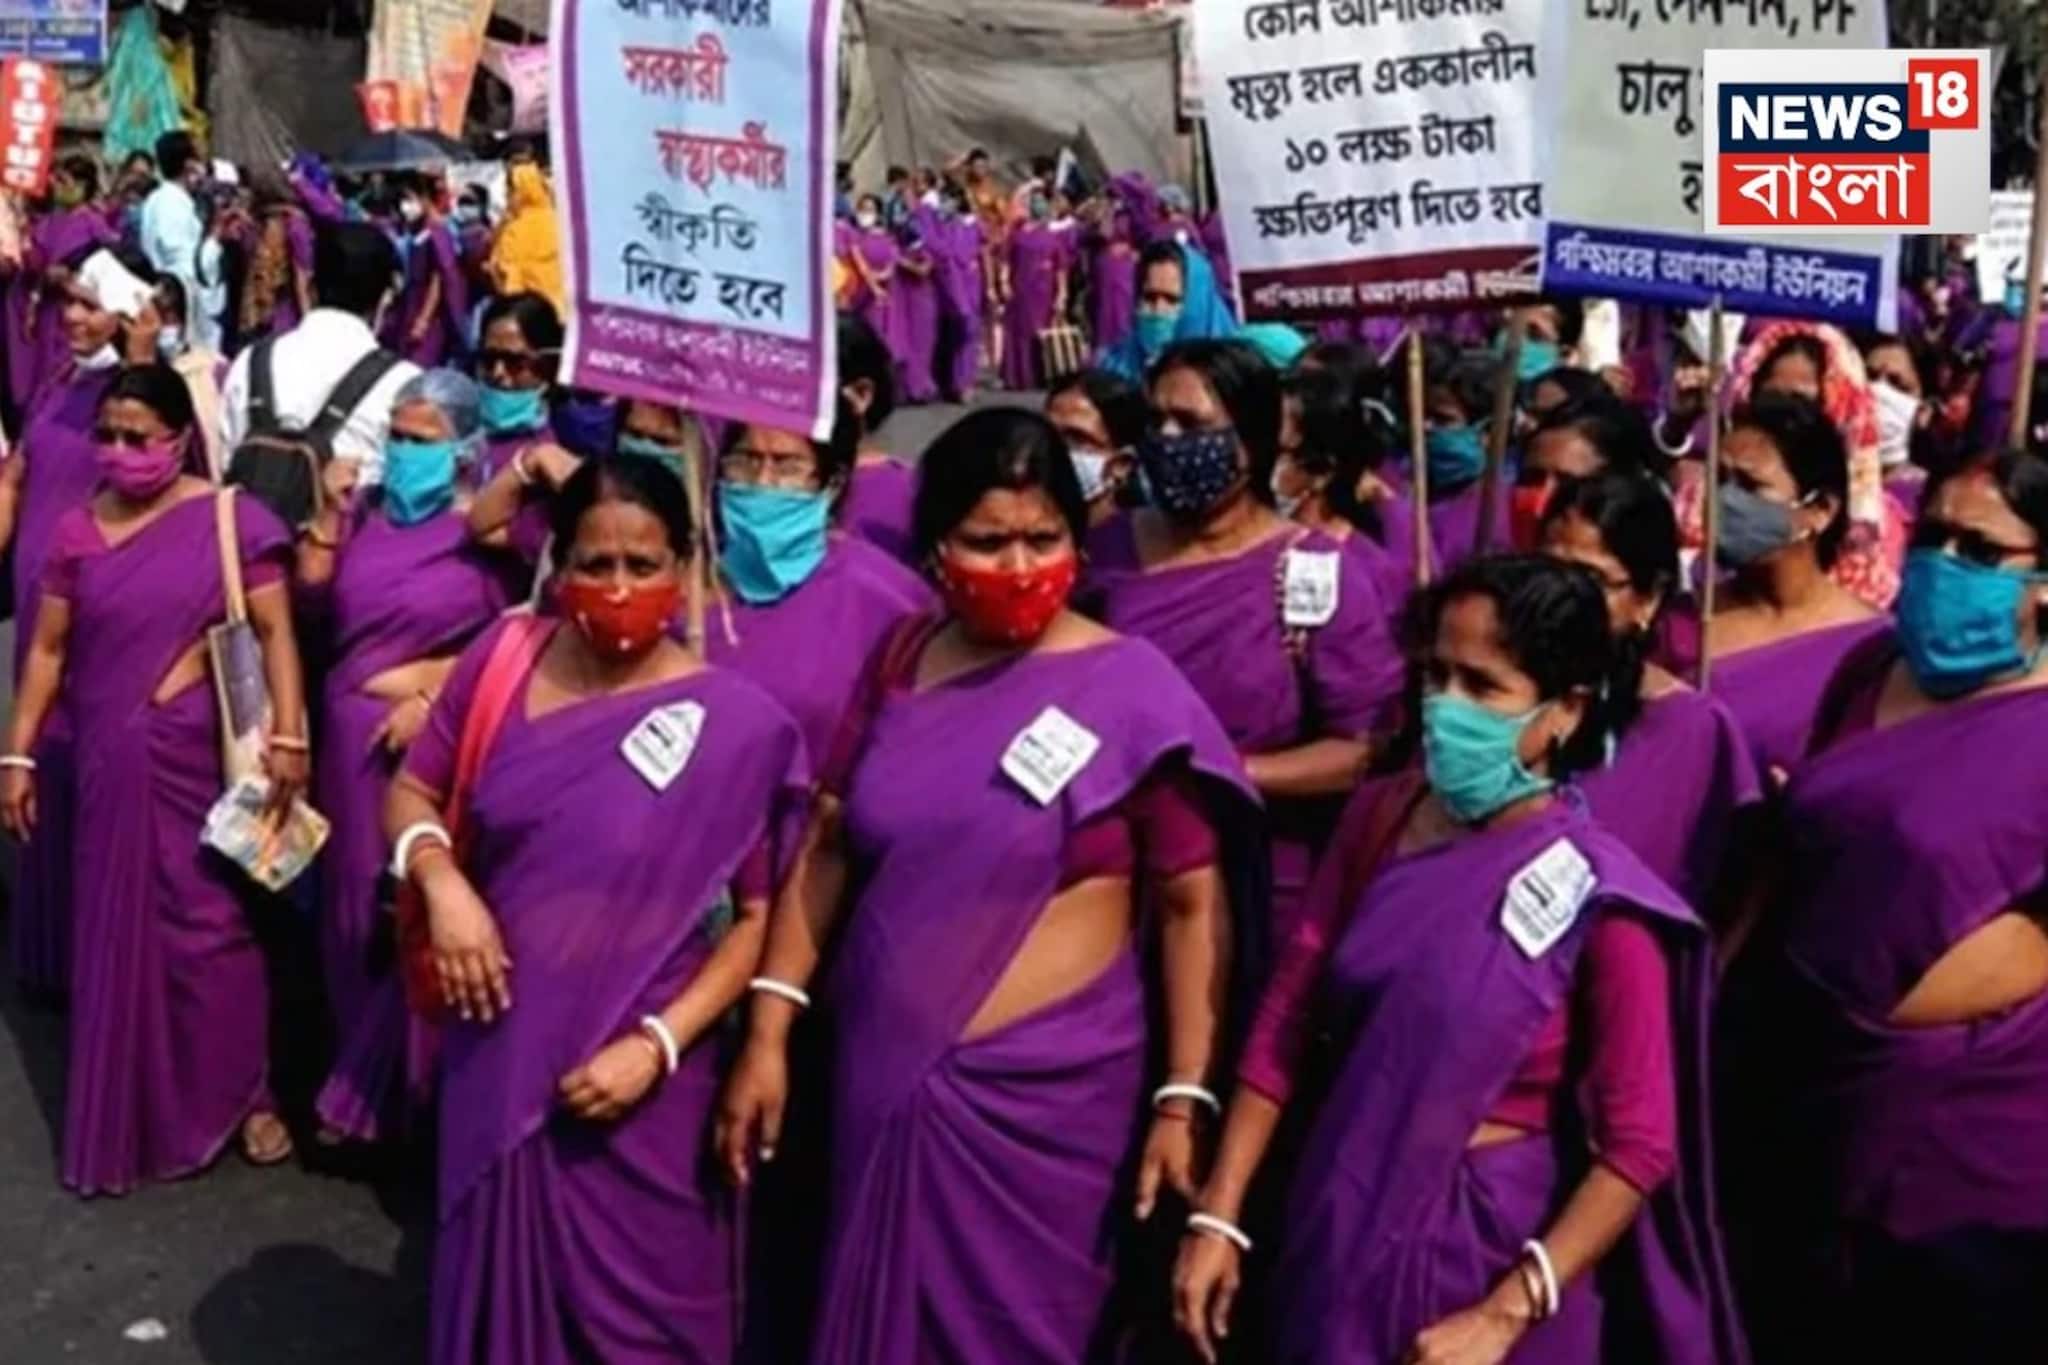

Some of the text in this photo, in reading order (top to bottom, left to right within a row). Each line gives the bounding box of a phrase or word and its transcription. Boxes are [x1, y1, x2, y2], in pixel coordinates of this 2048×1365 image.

[1244, 0, 1321, 40] কোন
[621, 33, 730, 105] সরকারী
[1227, 31, 1537, 121] মৃত্যু হলে এককালীন
[1617, 60, 1694, 136] চালু
[1285, 114, 1496, 172] ১০ লক্ষ টাকা
[634, 192, 758, 255] স্বীকৃতি
[1253, 179, 1543, 245] ক্ষতিপূরণ দিতে হবে
[621, 242, 787, 321] দিতে হবে
